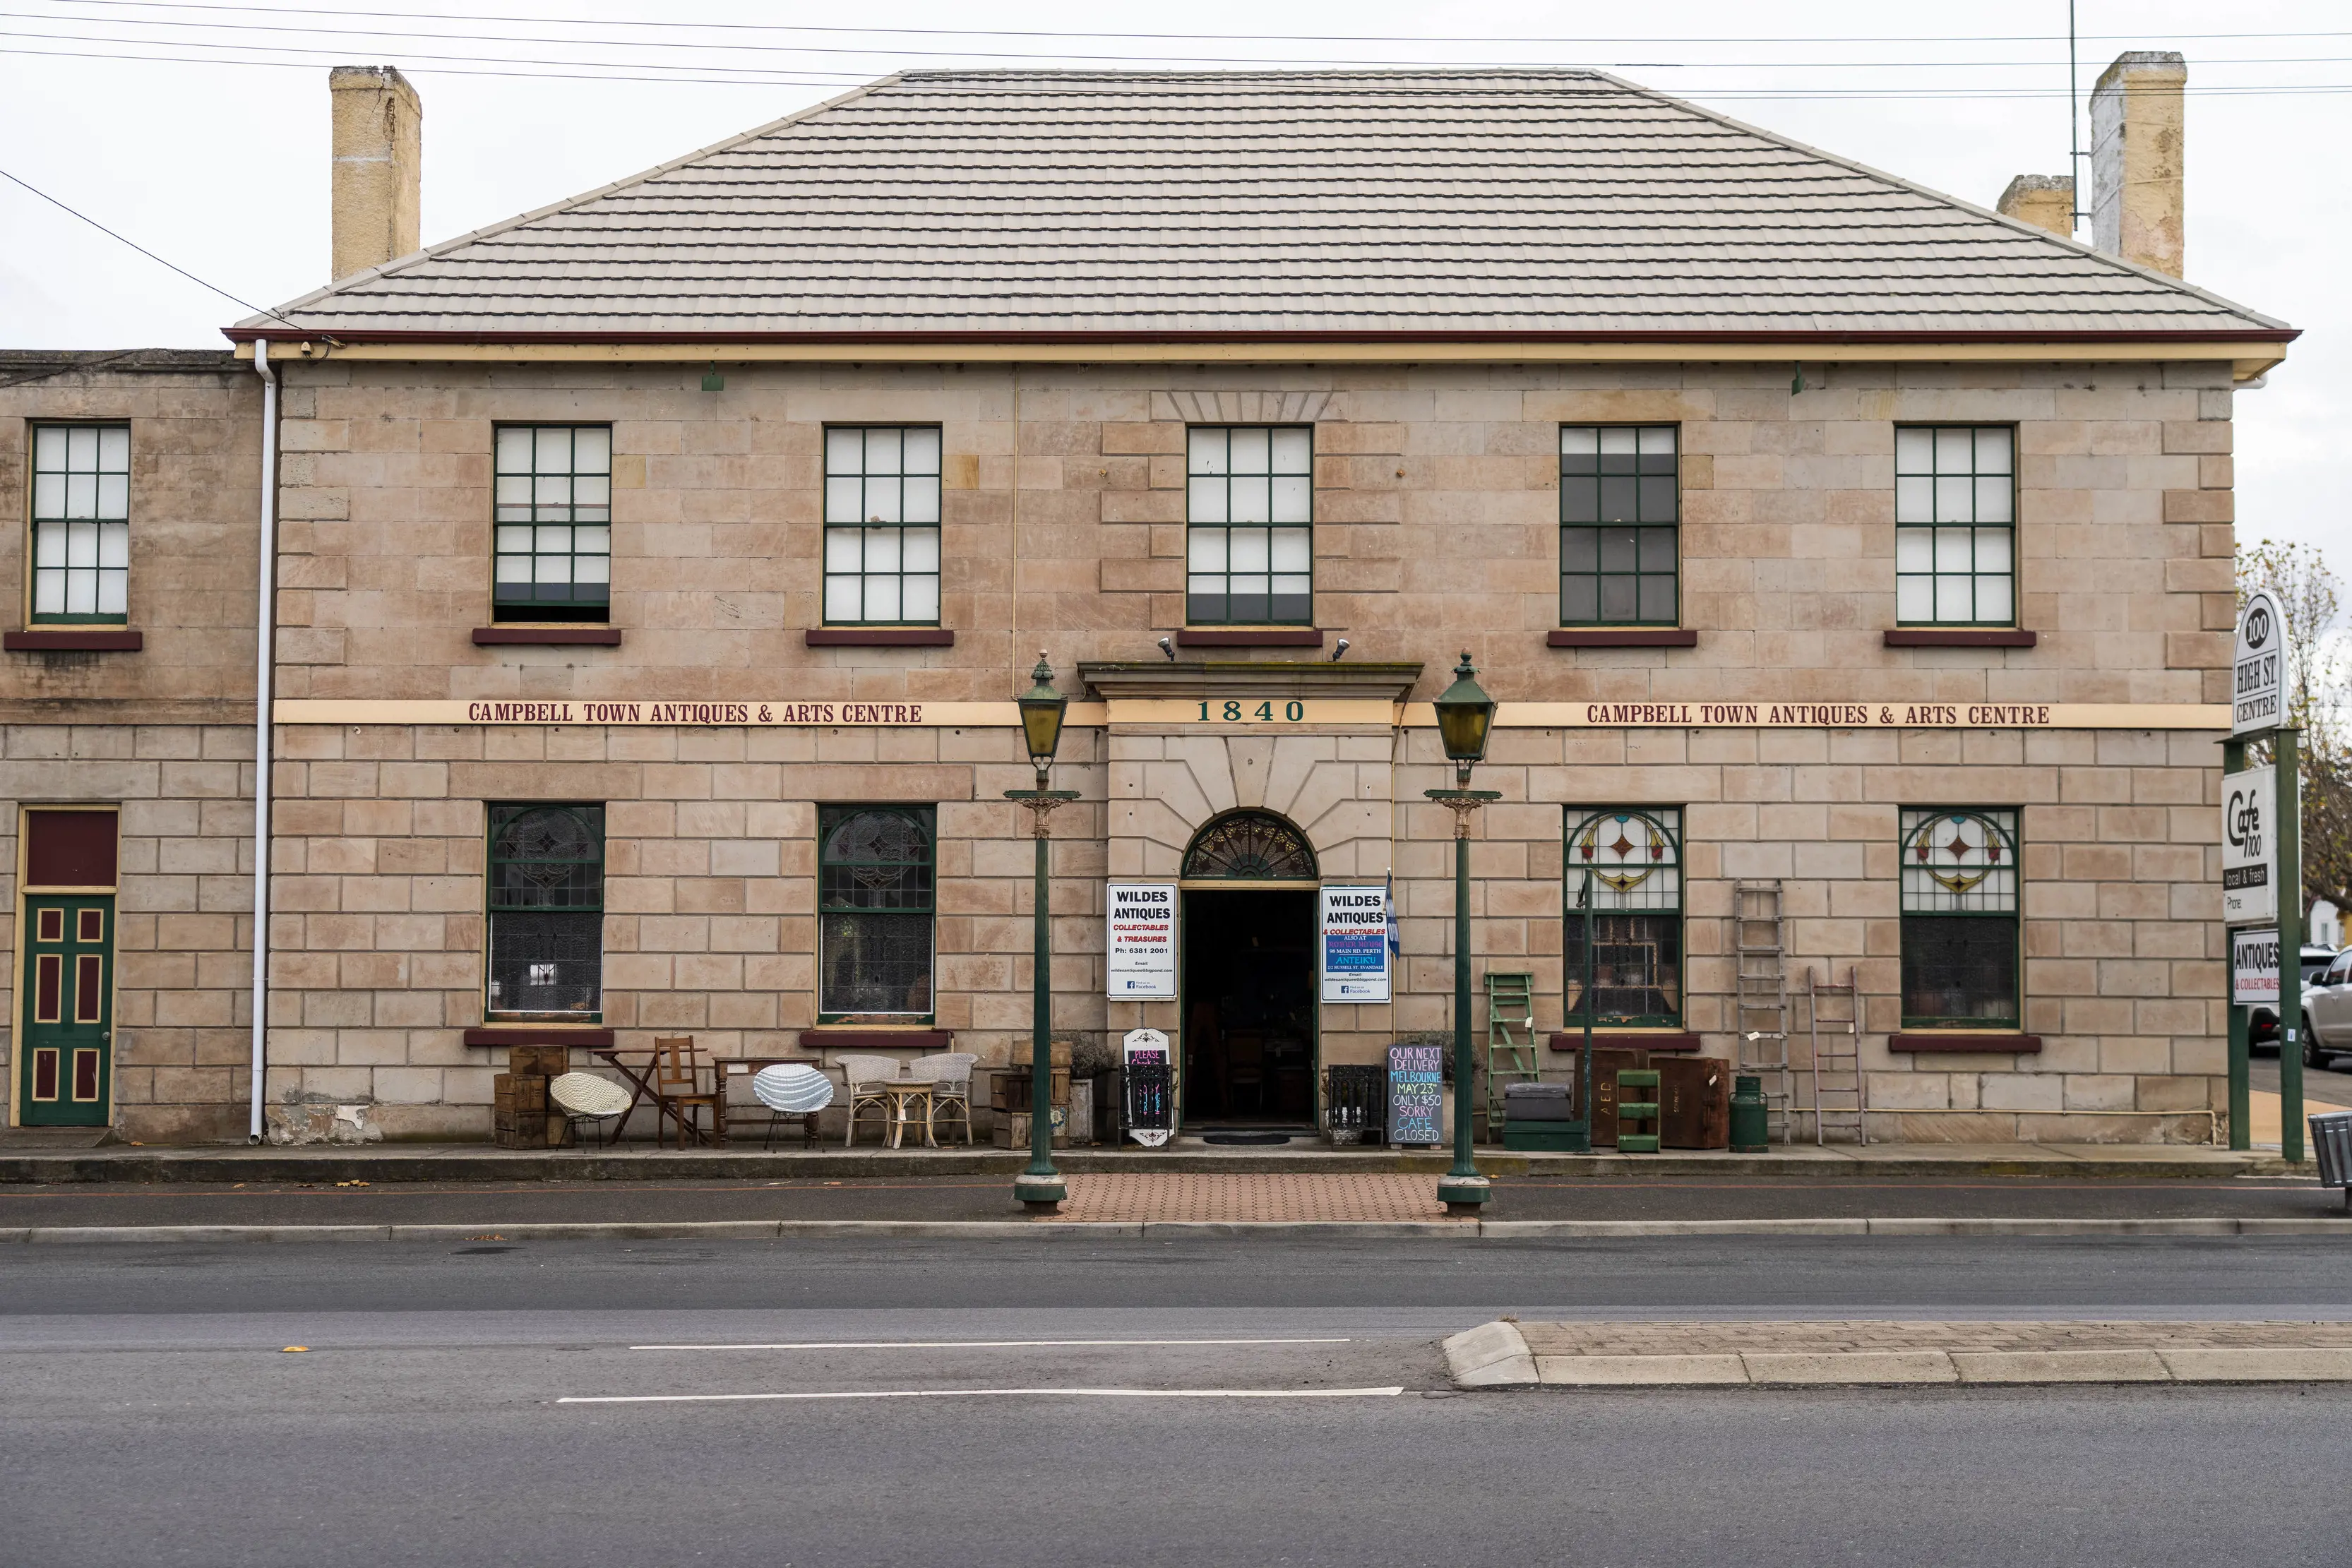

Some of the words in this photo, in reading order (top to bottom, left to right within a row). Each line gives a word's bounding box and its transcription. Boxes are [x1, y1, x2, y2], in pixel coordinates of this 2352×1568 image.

[2248, 614, 2267, 642] 100
[2237, 660, 2260, 693] HIGH
[2264, 655, 2276, 686] ST.
[469, 703, 573, 721] CAMPBELL
[584, 704, 640, 722] TOWN
[650, 705, 748, 724] ANTIQUES
[758, 705, 773, 722] &
[784, 705, 834, 722] ARTS
[842, 705, 921, 722] CENTRE
[1198, 701, 1303, 722] 1840
[1587, 705, 1692, 723] CAMPBELL
[1701, 706, 1757, 723] TOWN
[1769, 706, 1868, 725] ANTIQUES
[1880, 706, 1894, 724] &
[1905, 706, 1957, 724] ARTS
[1969, 706, 2049, 724] CENTRE
[2237, 695, 2276, 723] CENTRE
[2228, 789, 2260, 858] Cafe
[2248, 834, 2261, 857] 100
[2226, 870, 2240, 886] local
[2243, 870, 2247, 884] &
[2250, 868, 2264, 882] fresh
[1117, 892, 1168, 902] WILDES
[1330, 896, 1380, 906] WILDES
[2227, 897, 2241, 909] Phone:
[1114, 908, 1170, 921] ANTIQUES
[1327, 912, 1383, 925] ANTIQUES
[2235, 942, 2279, 973] ANTIQUES
[2235, 978, 2239, 989] &
[2240, 977, 2279, 991] COLLECTABLES
[1390, 1048, 1413, 1059] OUR
[1416, 1048, 1441, 1059] NEXT
[1395, 1060, 1440, 1071] DELIVERY
[1390, 1071, 1440, 1082] MELBOURNE
[1397, 1083, 1419, 1094] MAY
[1393, 1094, 1419, 1106] ONLY
[1421, 1094, 1441, 1106] $50
[1399, 1106, 1433, 1117] SORRY
[1394, 1130, 1438, 1141] CLOSED
